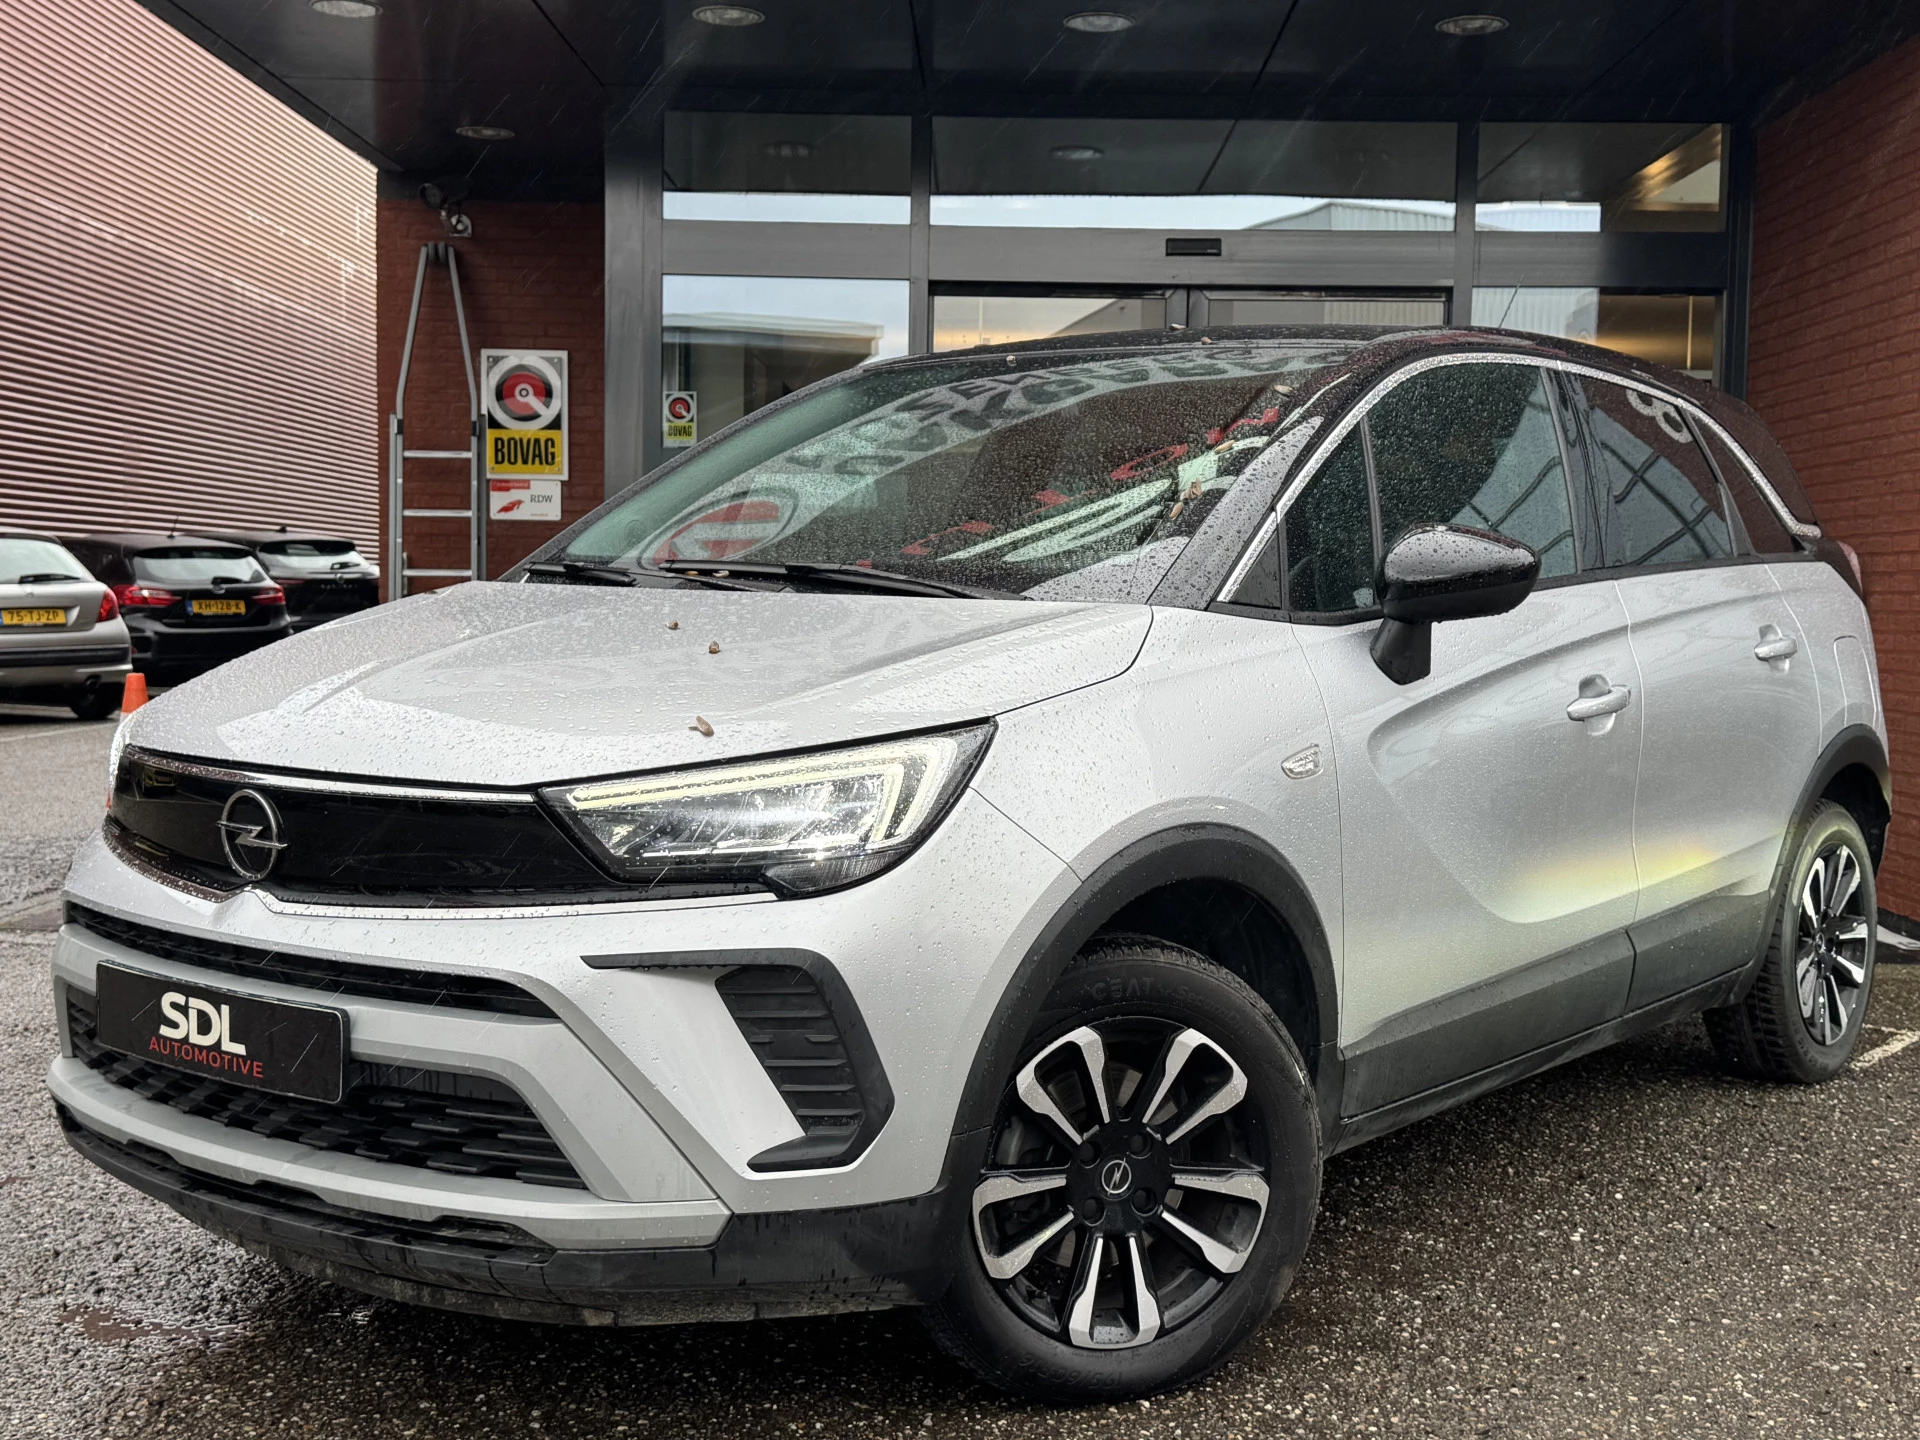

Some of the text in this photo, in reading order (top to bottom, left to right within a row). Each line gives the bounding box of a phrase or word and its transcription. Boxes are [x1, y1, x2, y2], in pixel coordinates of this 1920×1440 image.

[668, 425, 692, 437] BOVAG
[494, 437, 556, 466] BOVAG
[530, 494, 553, 503] RDW
[8, 610, 59, 621] 75-TJ-ZP
[1092, 977, 1154, 998] CEAT
[159, 991, 246, 1055] SDL
[149, 1036, 263, 1078] AUTOMOTIVE
